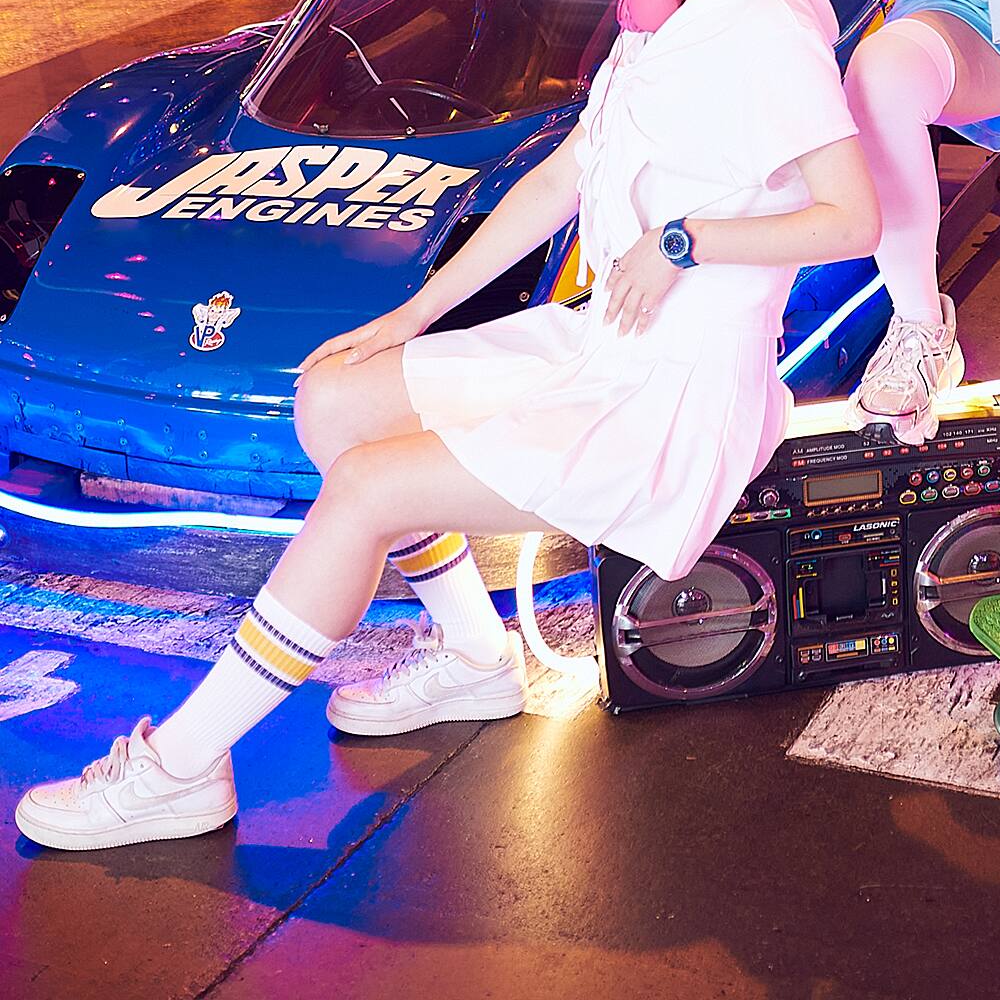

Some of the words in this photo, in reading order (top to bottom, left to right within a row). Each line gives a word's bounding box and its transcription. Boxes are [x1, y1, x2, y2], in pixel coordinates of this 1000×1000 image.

[91, 145, 480, 219] JASPER
[160, 196, 438, 232] ENGINES
[853, 520, 898, 532] LASONIC
